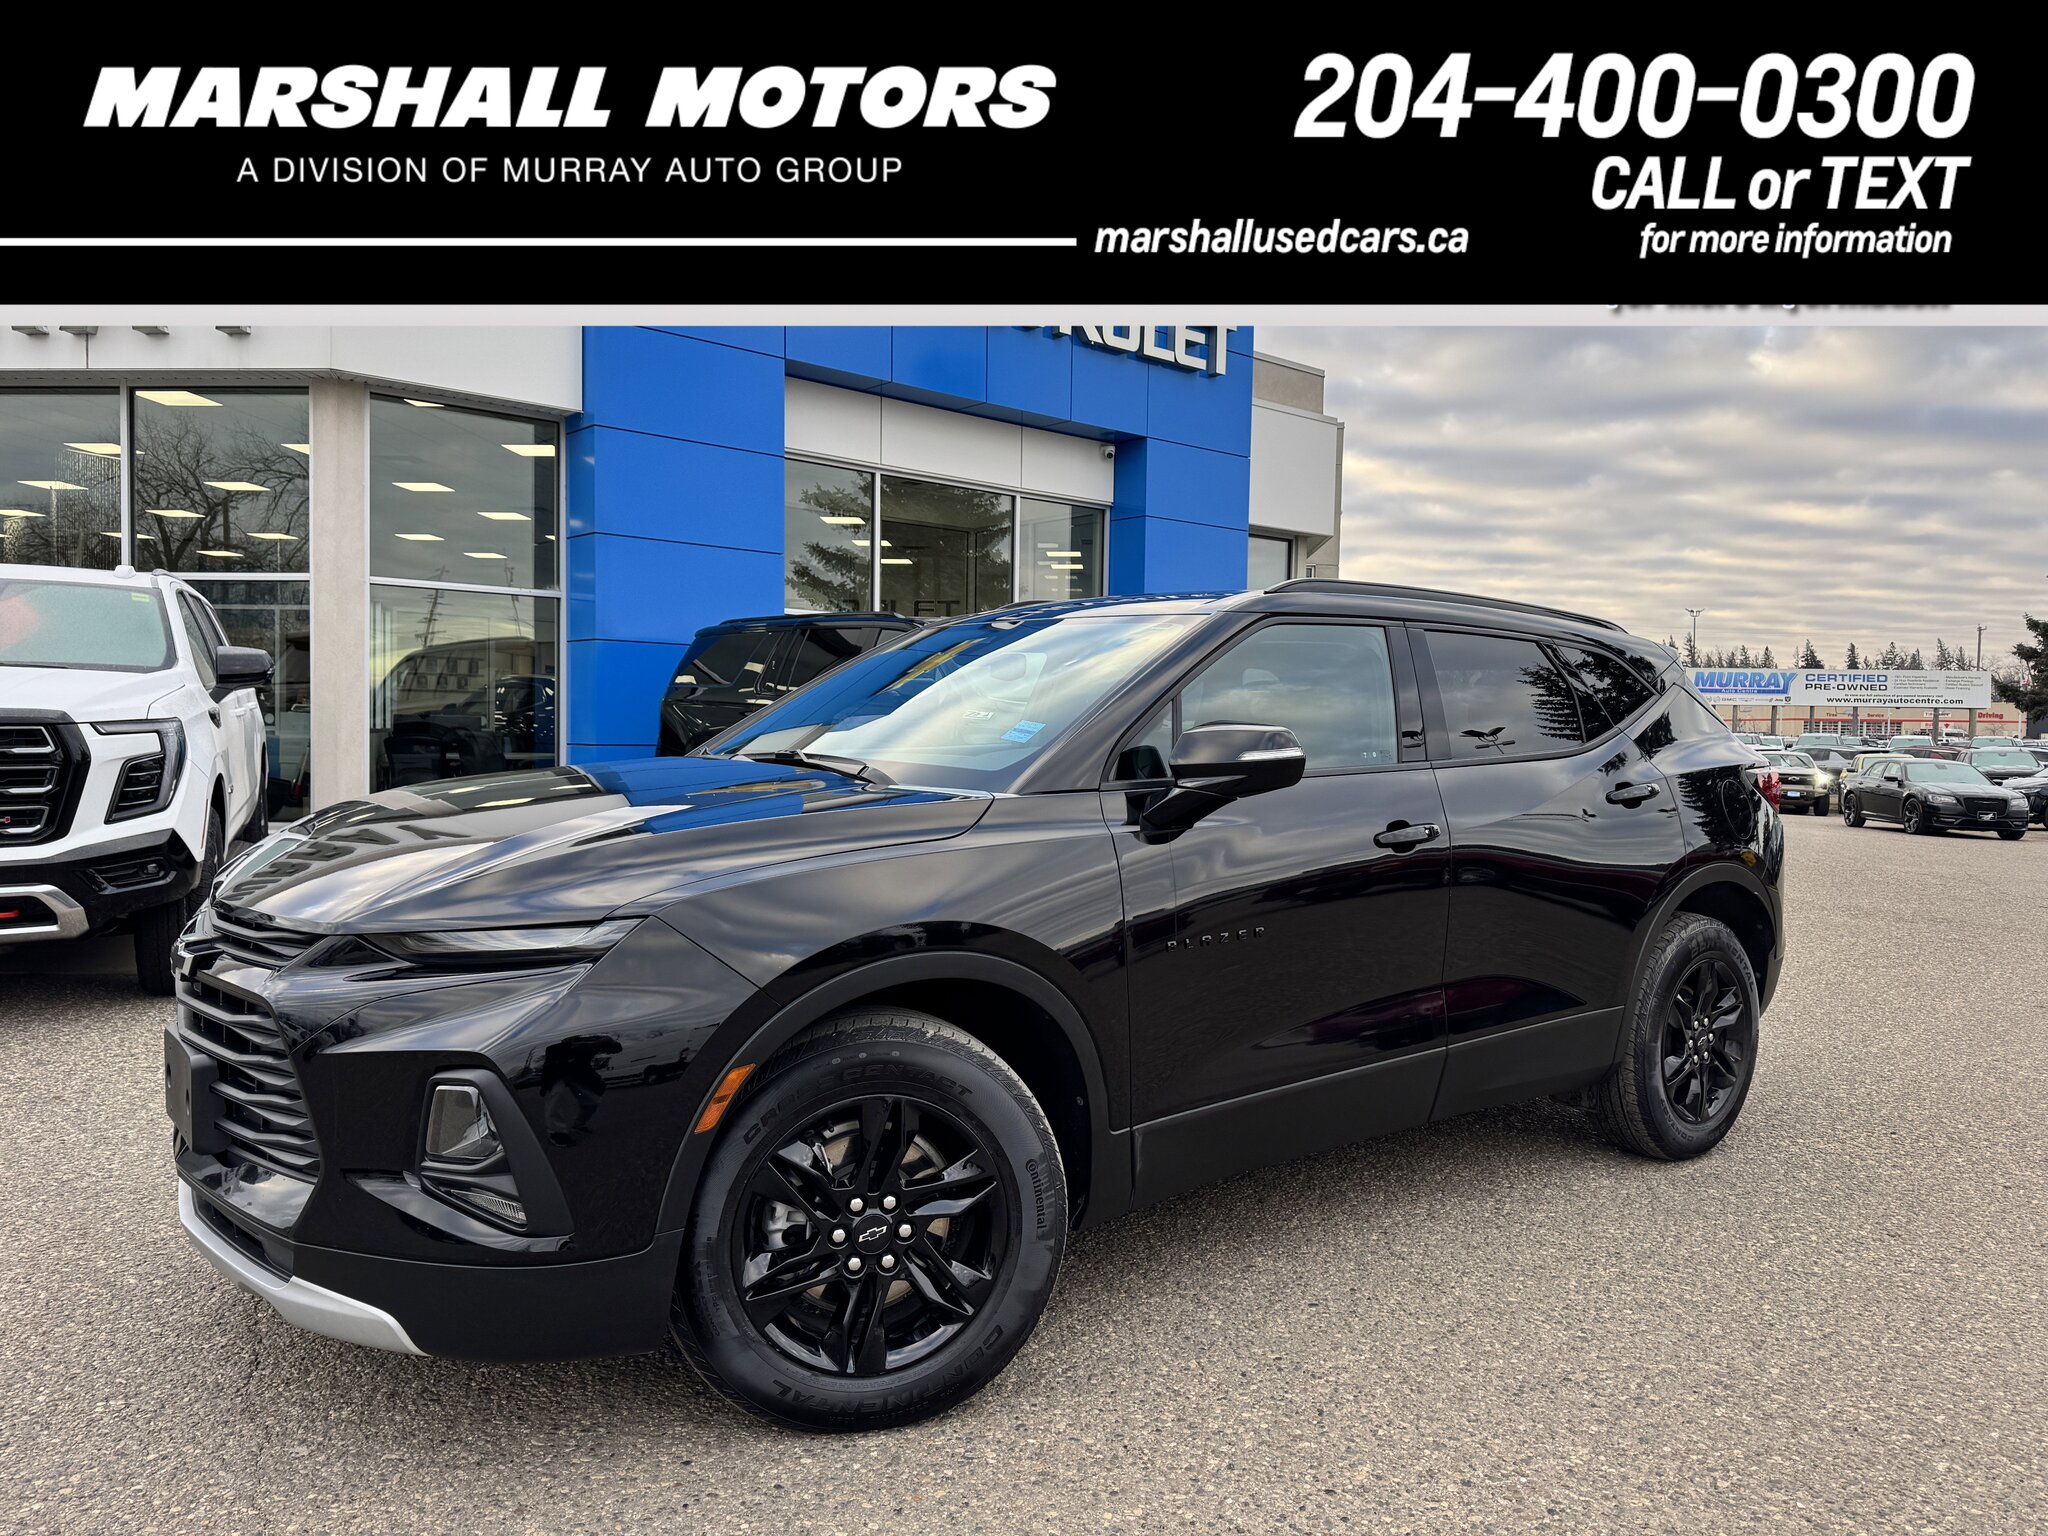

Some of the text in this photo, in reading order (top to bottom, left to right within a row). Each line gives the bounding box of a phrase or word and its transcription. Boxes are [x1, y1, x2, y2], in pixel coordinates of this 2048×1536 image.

[1694, 671, 1799, 691] MURRAY
[1805, 674, 1888, 683] CERTIFIED
[1805, 683, 1888, 692] PRE-OWNED
[1827, 697, 1964, 705] www.murrayautocentre.com
[1165, 926, 1265, 953] BLAZER
[1025, 1158, 1047, 1229] Continental
